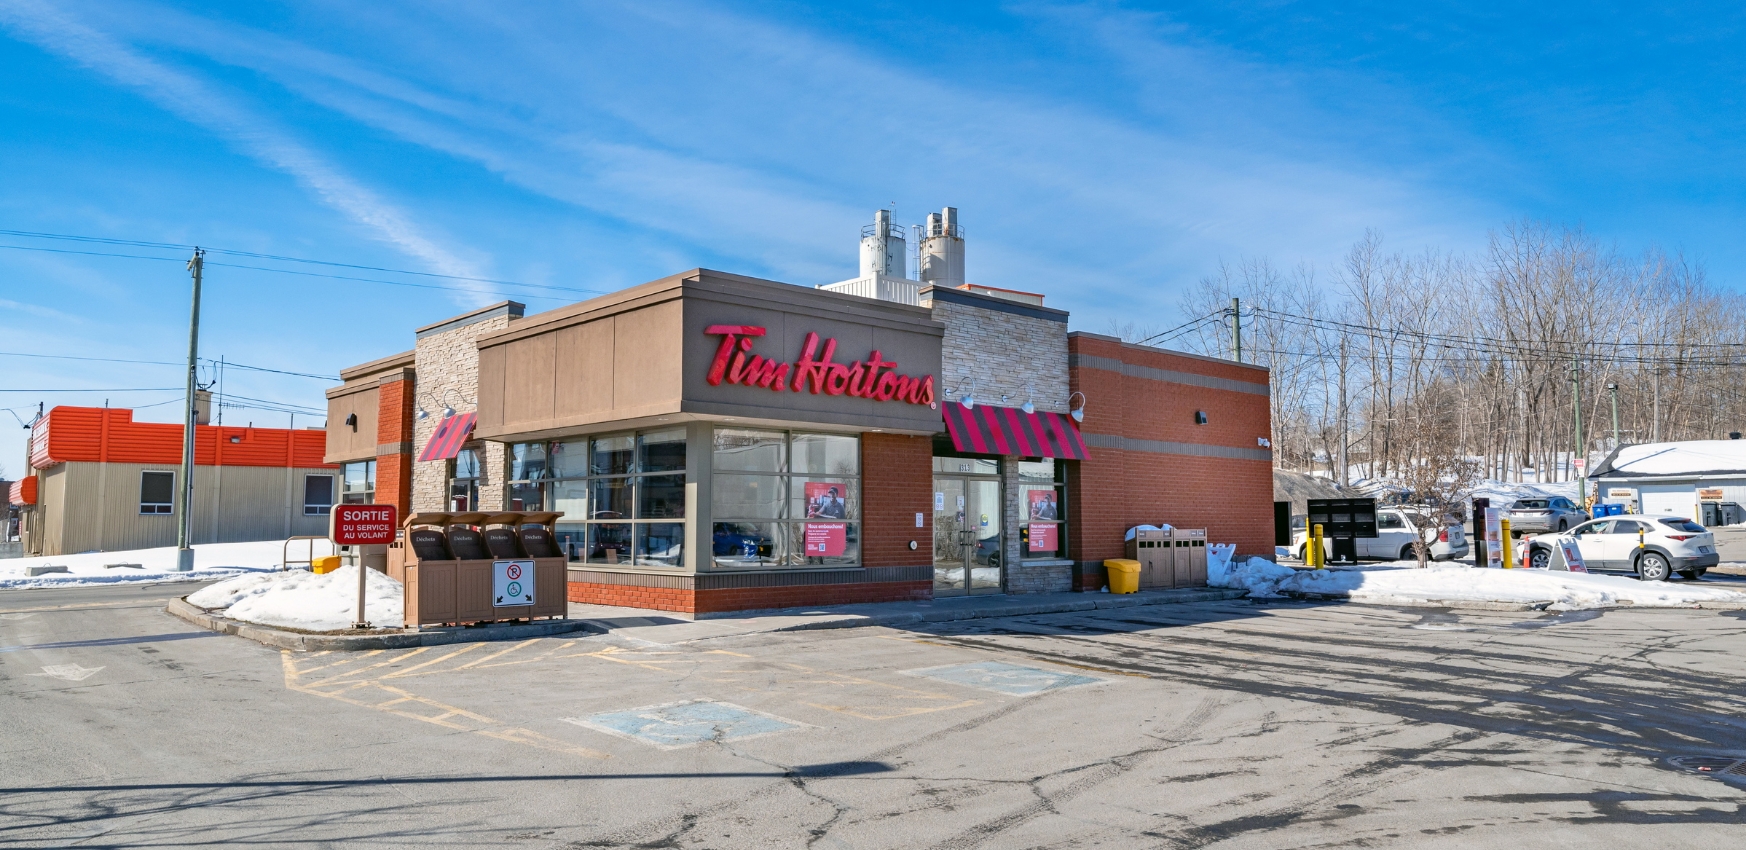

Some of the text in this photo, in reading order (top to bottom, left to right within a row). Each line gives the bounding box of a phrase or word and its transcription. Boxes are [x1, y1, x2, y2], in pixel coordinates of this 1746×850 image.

[703, 324, 935, 405] Tim Hortons
[343, 510, 390, 521] SORTIE
[356, 523, 390, 531] SERVICE
[357, 531, 389, 539] VOLANT
